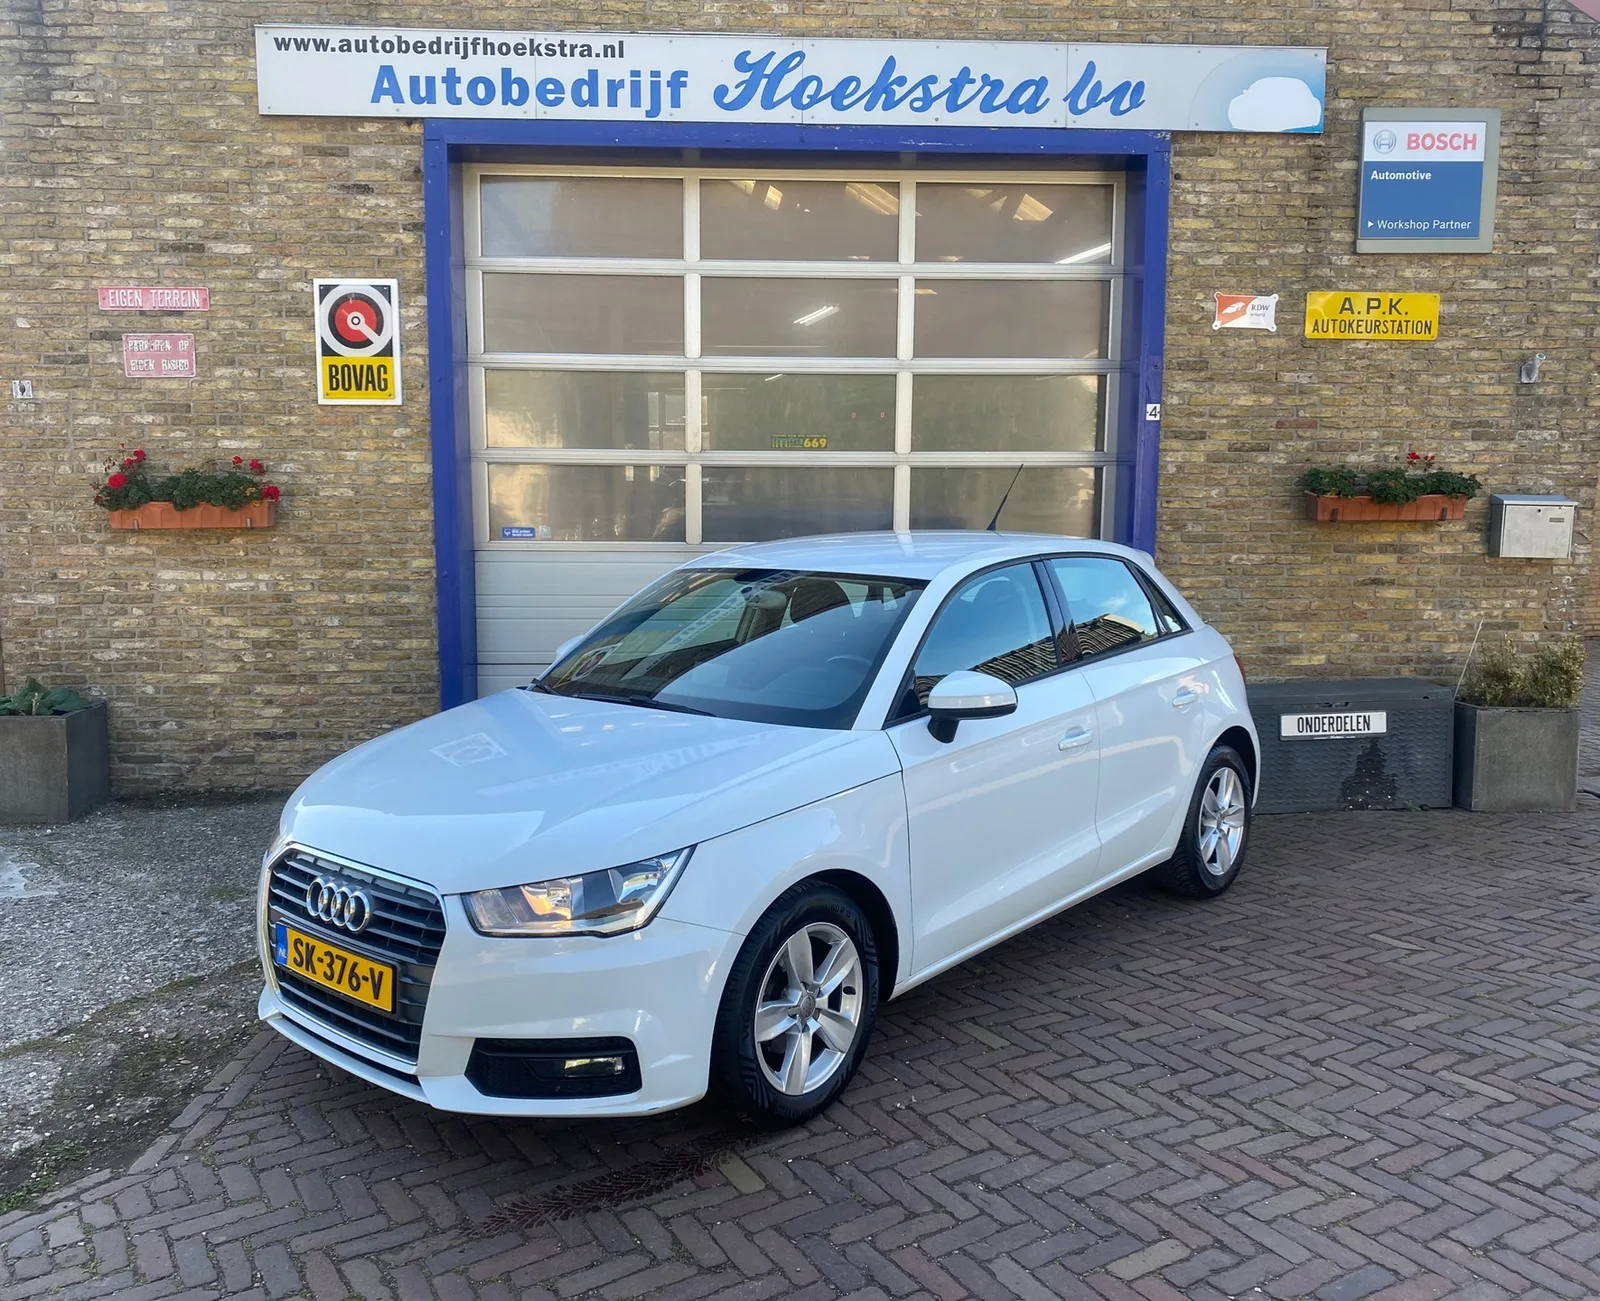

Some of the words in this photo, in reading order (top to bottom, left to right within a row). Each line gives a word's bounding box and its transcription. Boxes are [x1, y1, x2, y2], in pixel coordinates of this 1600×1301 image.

[273, 35, 625, 60] www.autobedrijfhoekstra.nl
[370, 64, 689, 119] Autobedrijf
[712, 49, 1050, 117] Hoekstra
[1063, 60, 1146, 117] bv
[1406, 132, 1477, 151] BOSCH
[1370, 170, 1432, 180] Automotive
[1376, 219, 1430, 231] Workshop
[1432, 219, 1472, 230] Partner
[108, 289, 143, 308] EIGEN
[150, 289, 201, 308] TERREIN
[1338, 297, 1409, 316] A.P.K.
[1311, 319, 1433, 335] AUTOKEURSTATION
[328, 364, 389, 392] BOVAG
[1149, 405, 1158, 419] 4
[803, 438, 827, 448] 669
[1297, 714, 1371, 734] ONDERDELEN
[292, 937, 384, 1000] SK-376-V
